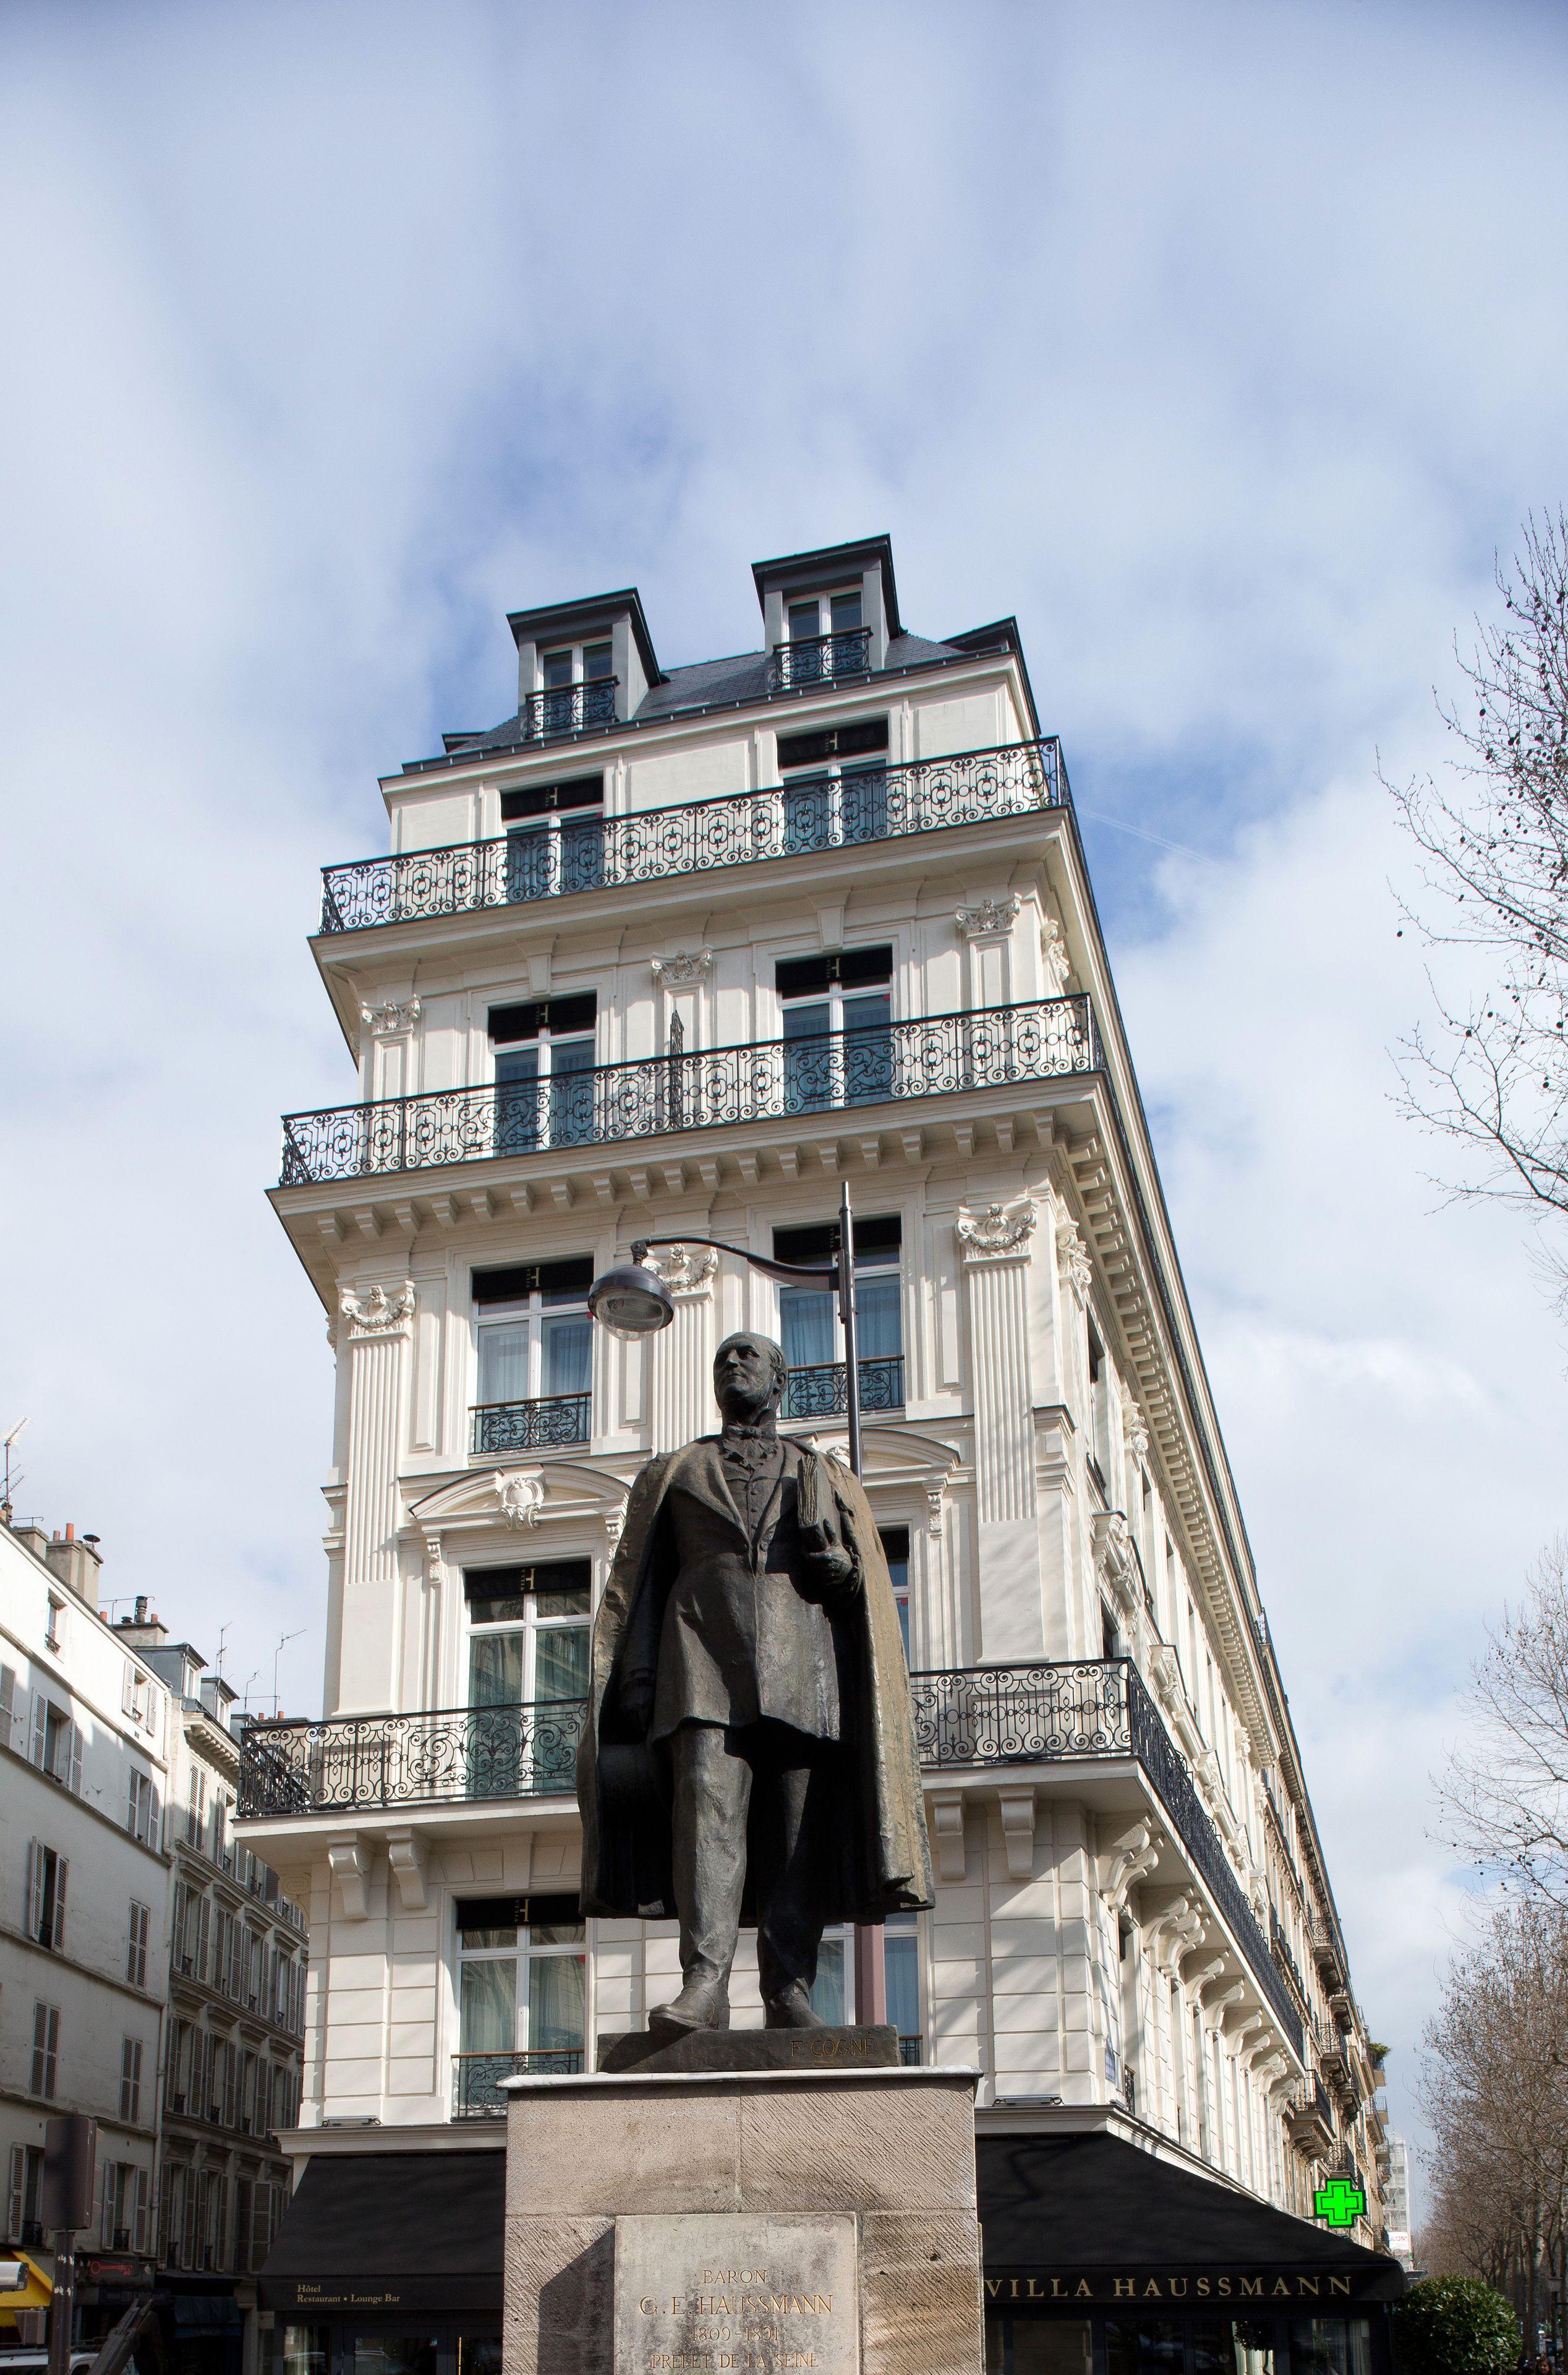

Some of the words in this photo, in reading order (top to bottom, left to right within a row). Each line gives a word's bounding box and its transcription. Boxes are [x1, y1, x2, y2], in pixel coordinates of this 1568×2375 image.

[790, 2040, 805, 2057] F.
[703, 2269, 767, 2283] BARON
[297, 2285, 320, 2293] Hôtel
[984, 2278, 1093, 2297] VILLA
[1113, 2277, 1351, 2296] HAUSSMANN
[350, 2295, 383, 2304] Lounge
[639, 2295, 665, 2315] G.
[671, 2296, 692, 2314] E.
[699, 2294, 832, 2314] HAUSSMANN
[651, 2353, 710, 2368] PREFET
[720, 2353, 739, 2368] DE
[747, 2353, 768, 2368] LA
[773, 2352, 818, 2368] SEINE
